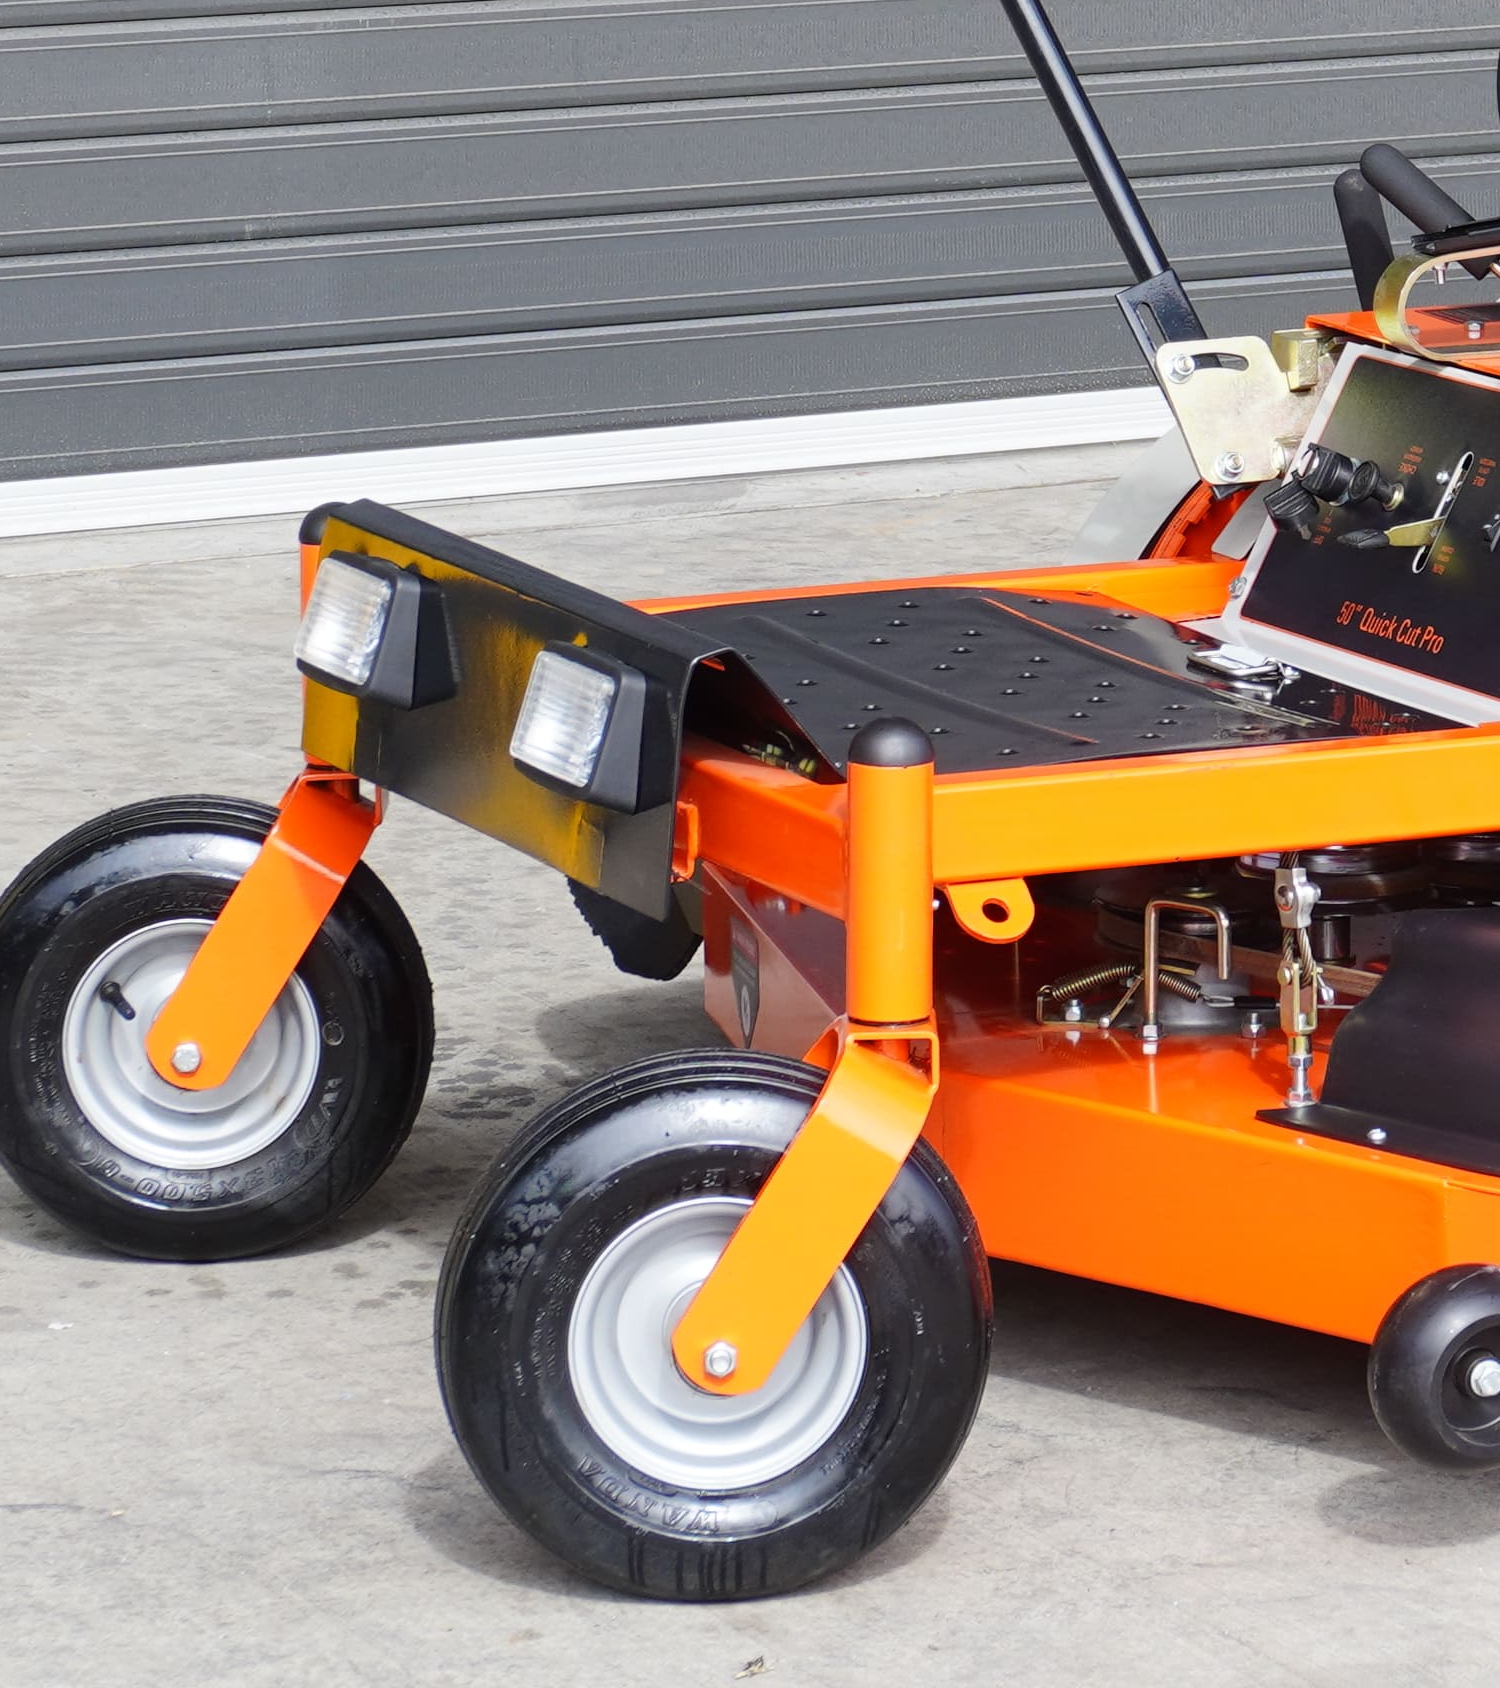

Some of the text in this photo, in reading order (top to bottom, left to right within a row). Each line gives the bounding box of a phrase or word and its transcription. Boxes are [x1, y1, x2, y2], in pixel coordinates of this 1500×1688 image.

[1336, 600, 1445, 655] 50" Quick Cut Pro
[577, 1455, 719, 1534] WANDA
